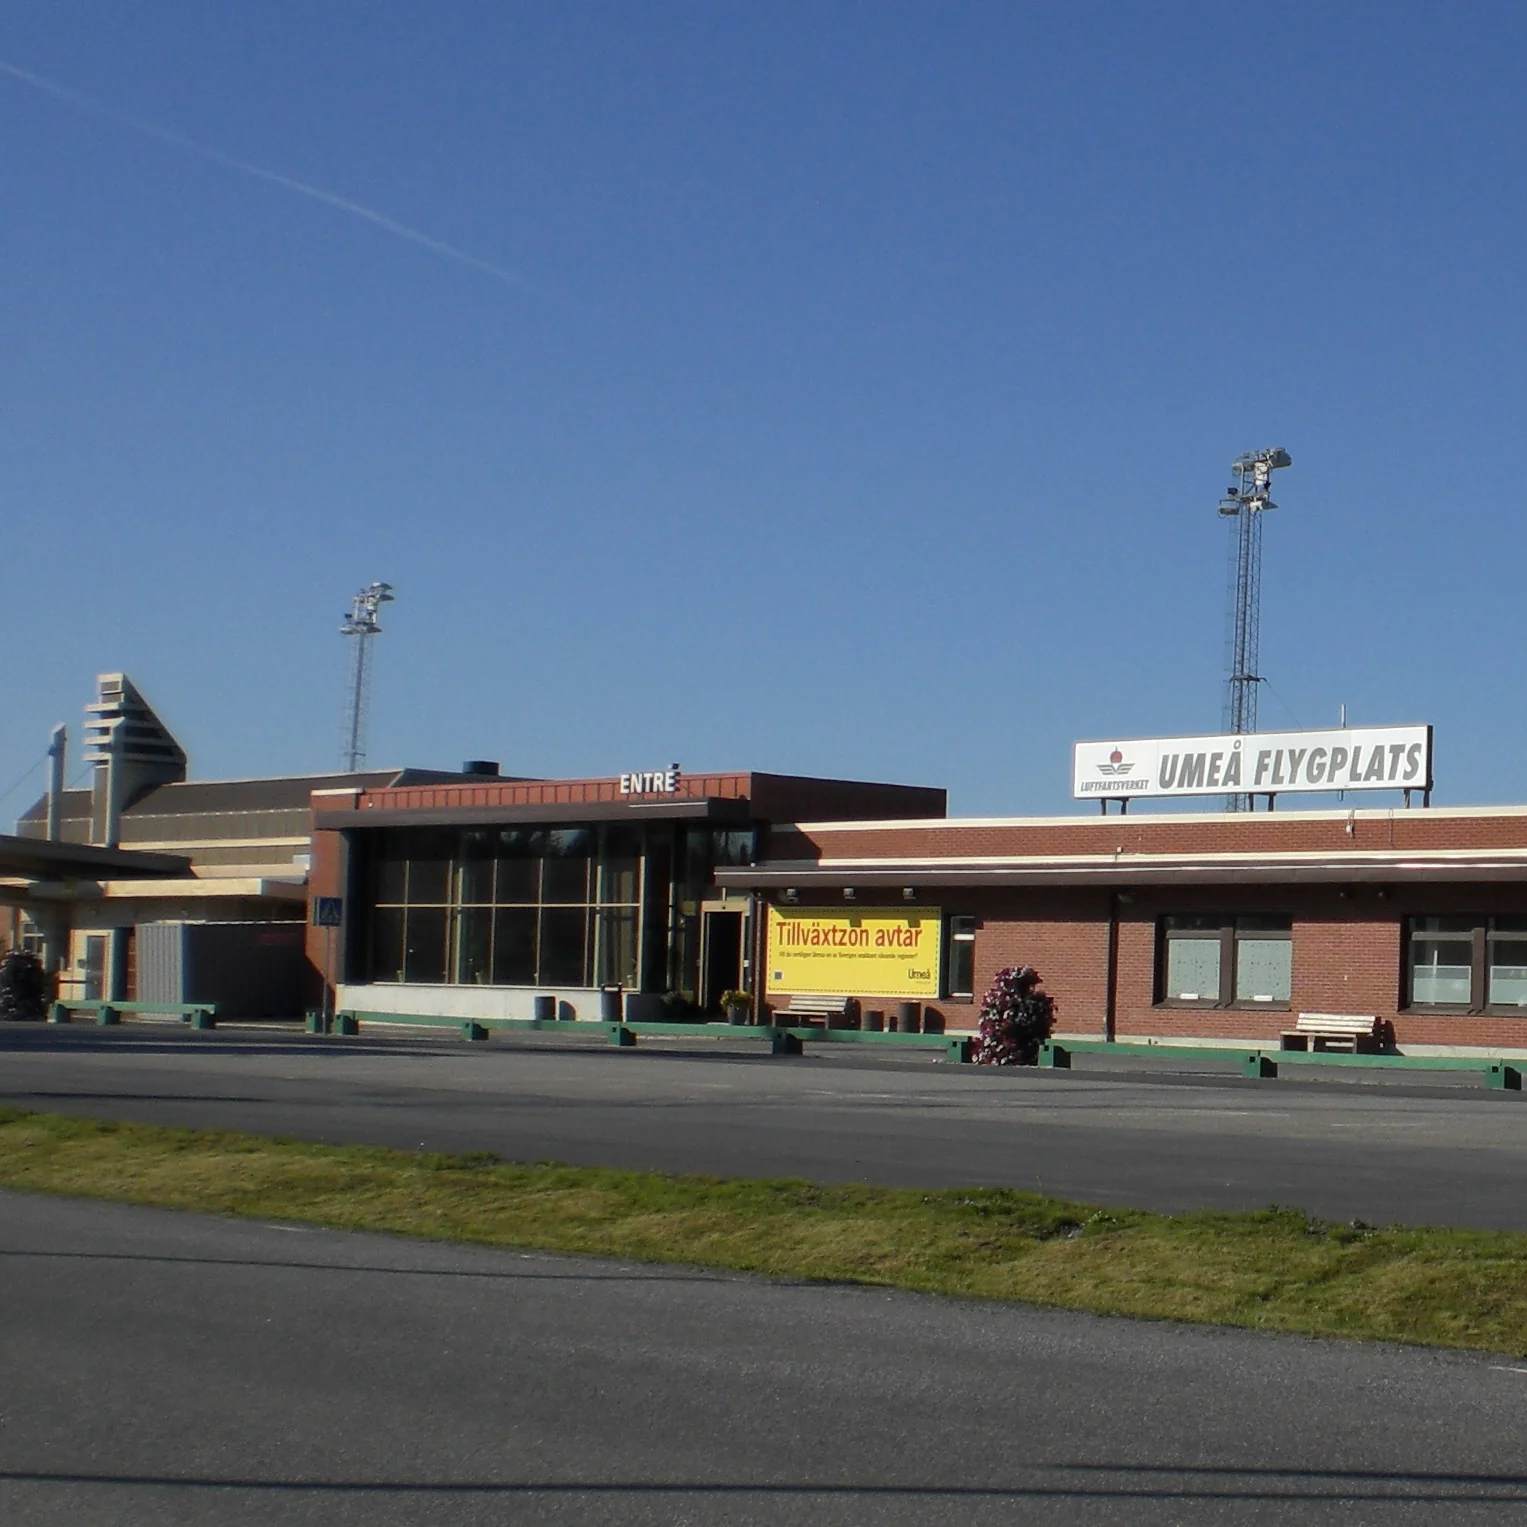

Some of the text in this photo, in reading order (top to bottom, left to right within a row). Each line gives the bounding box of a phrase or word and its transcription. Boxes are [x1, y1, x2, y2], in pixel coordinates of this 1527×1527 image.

[1158, 739, 1422, 789] UMEÅ FLYGPLATS
[620, 762, 678, 794] ENTRÉ
[1080, 779, 1150, 792] LUFTFARTSVERKET
[776, 922, 922, 947] Tillväxtzon avtar
[908, 967, 931, 980] Umeå
